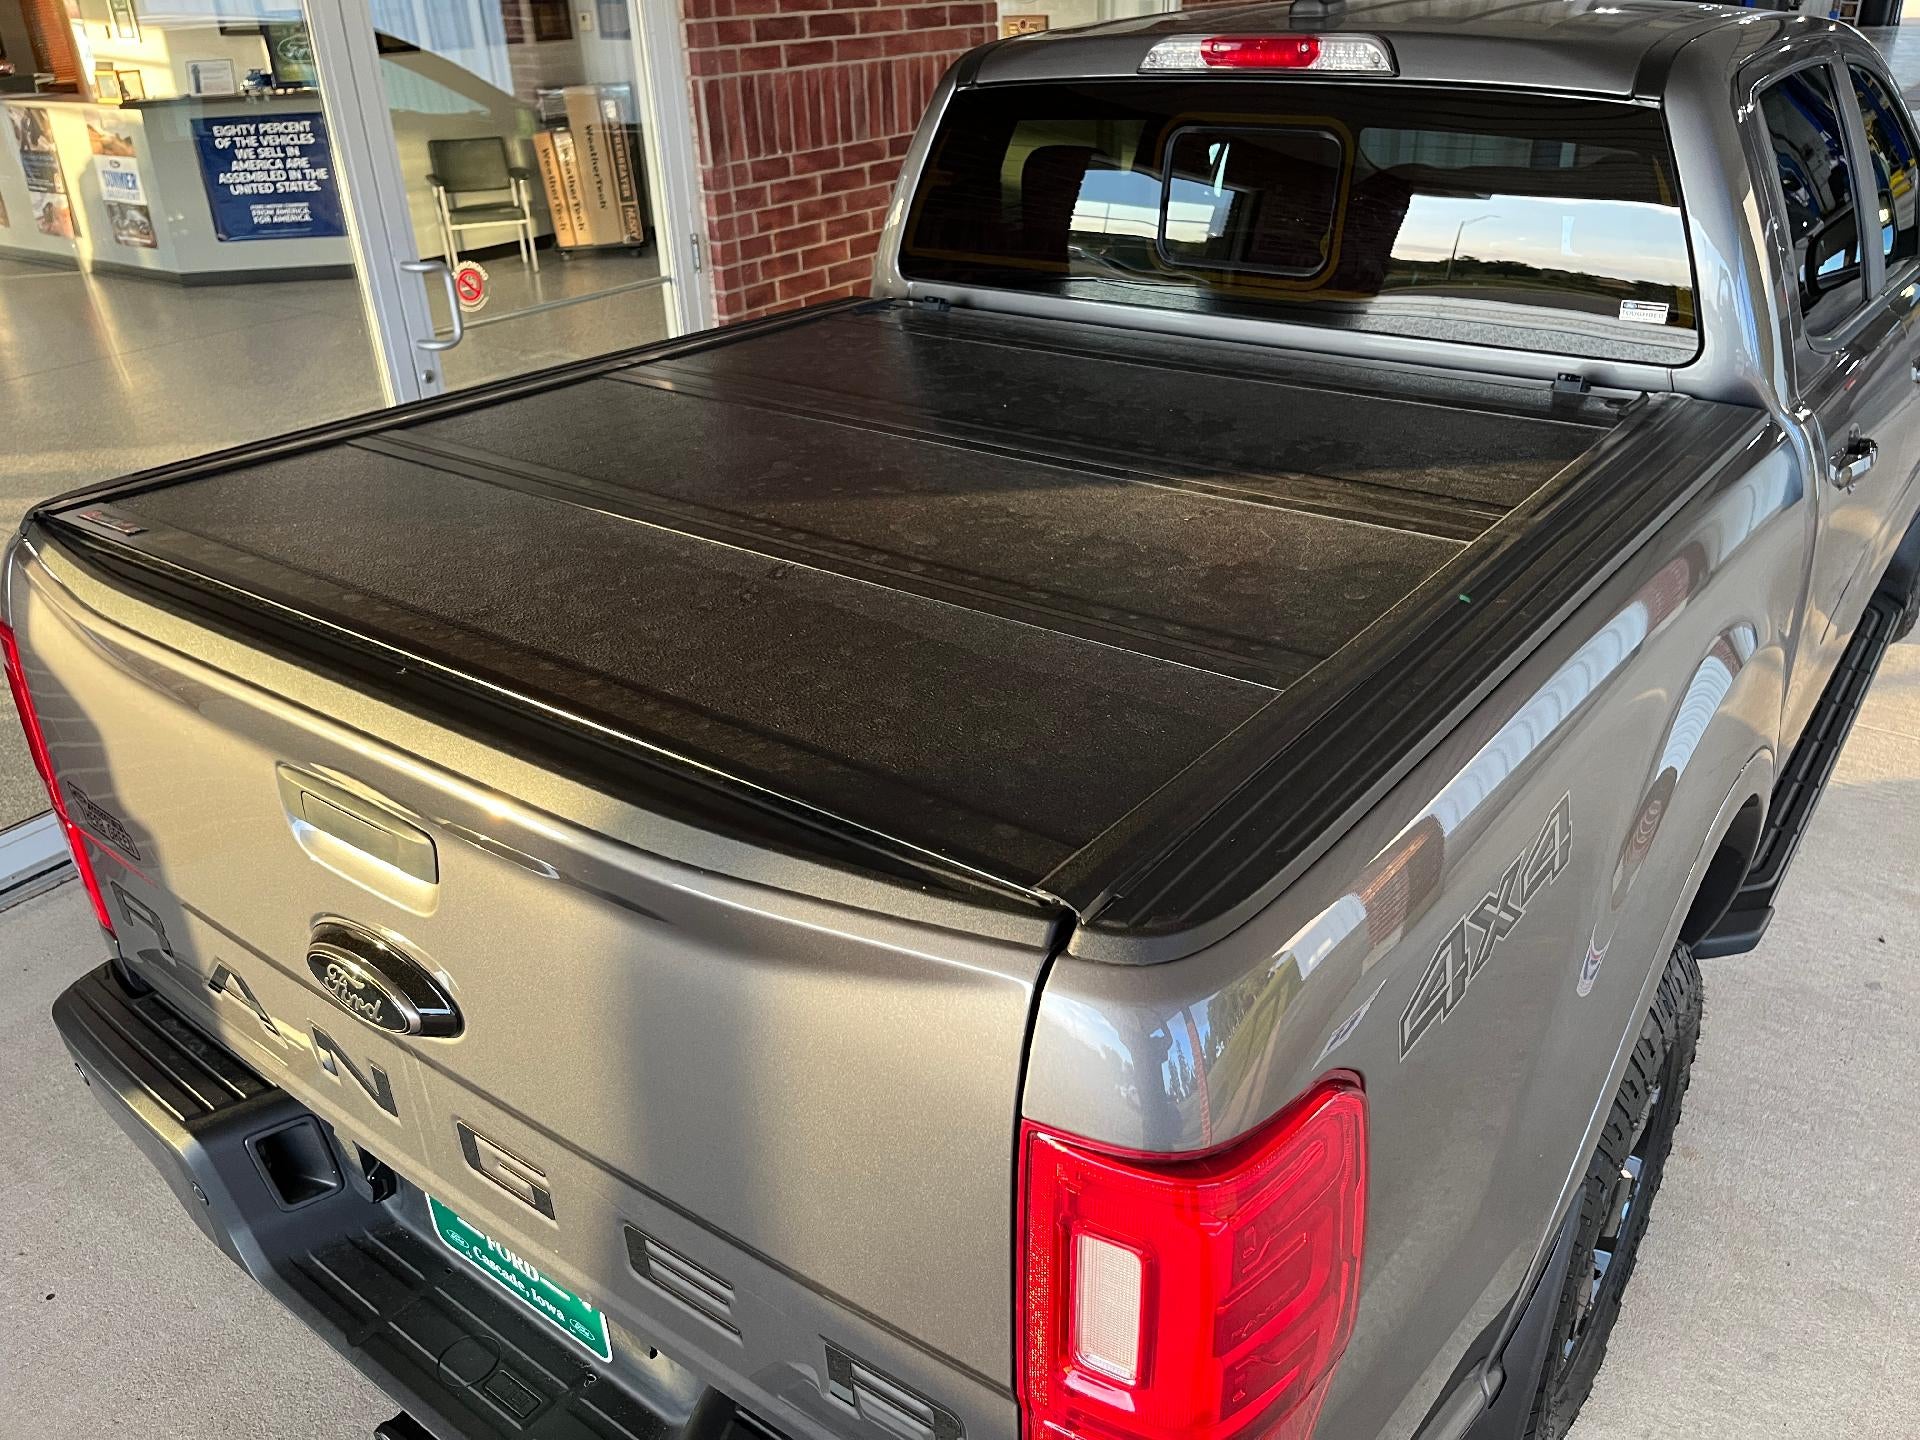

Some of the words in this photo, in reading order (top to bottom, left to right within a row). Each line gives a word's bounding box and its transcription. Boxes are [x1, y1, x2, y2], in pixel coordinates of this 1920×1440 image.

[212, 124, 257, 137] EIGHTY
[258, 121, 311, 135] PERCENT
[214, 137, 232, 149] OF
[232, 135, 259, 148] THE
[259, 132, 315, 146] VEHICLES
[234, 148, 257, 160] WE
[257, 146, 285, 158] SELL
[285, 145, 300, 157] IN
[231, 158, 284, 172] AMERICA
[285, 157, 310, 169] ARE
[584, 124, 608, 209] WeatherTech
[219, 170, 287, 184] ASSEMBLED
[288, 169, 302, 181] IN
[302, 168, 329, 180] THE
[229, 182, 274, 195] UNITED
[275, 180, 321, 193] STATES.
[542, 147, 567, 231] WeatherTech
[324, 963, 383, 1022] Ford
[473, 1245, 530, 1298] Cascade,
[531, 1287, 565, 1322] Iowa
